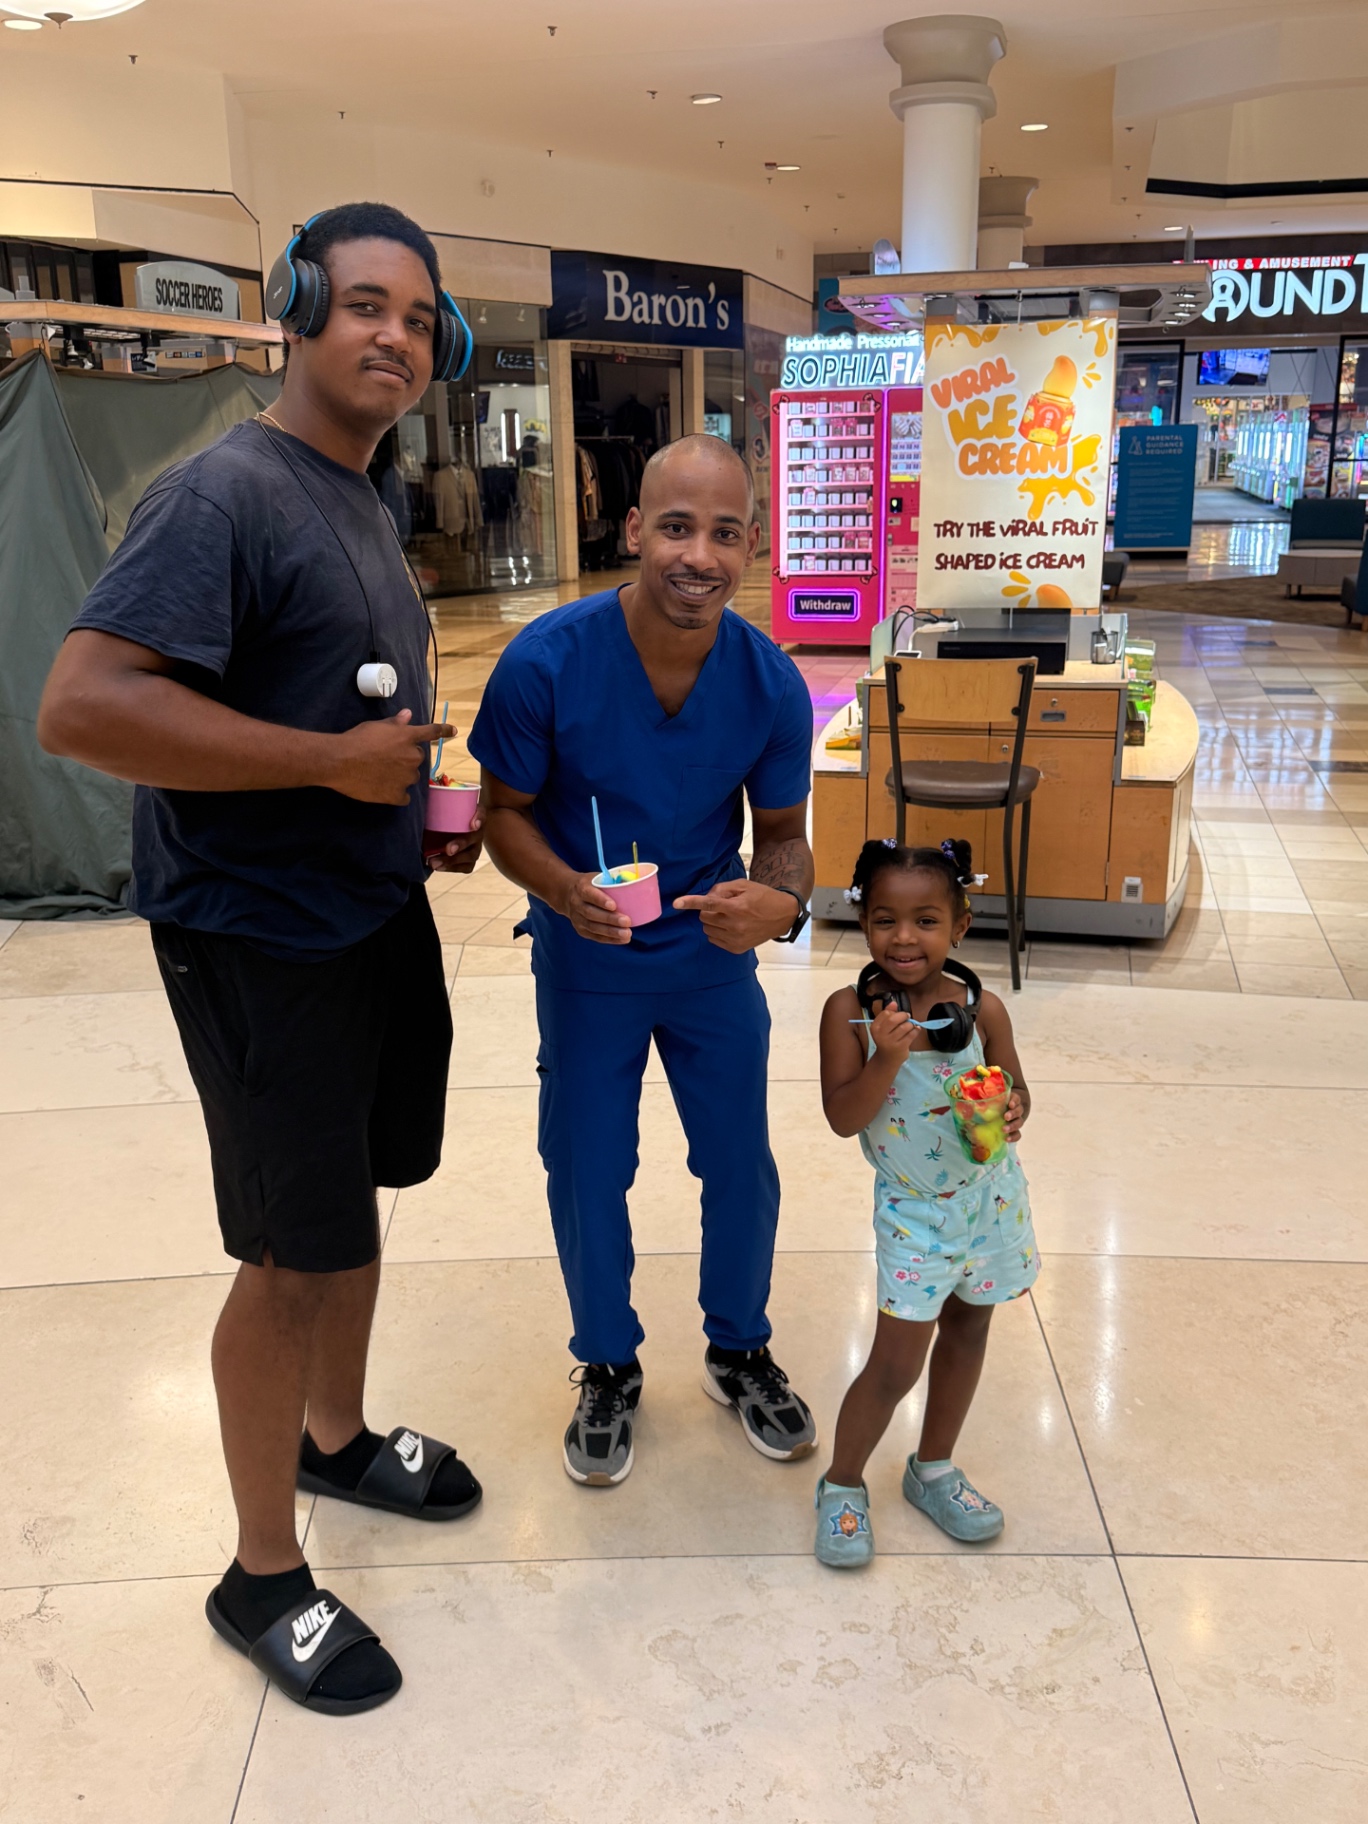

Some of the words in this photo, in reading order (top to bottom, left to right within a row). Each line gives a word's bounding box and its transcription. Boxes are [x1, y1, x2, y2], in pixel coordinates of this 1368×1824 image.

[1244, 259, 1254, 269] &
[1259, 255, 1351, 269] AMUSEMENT
[155, 277, 190, 309] SOCCER
[191, 283, 223, 313] HEROES
[786, 334, 853, 352] Handmade
[930, 357, 1015, 409] VIRAL
[948, 394, 1018, 446] ICE
[1145, 441, 1184, 449] GUIDANCE
[1146, 434, 1182, 442] PARENTAL
[958, 442, 1068, 476] CREAM
[933, 519, 964, 539] TRY
[967, 520, 996, 538] THE
[934, 552, 996, 571] SHAPED
[1026, 551, 1086, 570] CREAM
[799, 599, 852, 611] Withdraw
[394, 1430, 420, 1460] NIKE
[291, 1600, 334, 1644] NIKE
